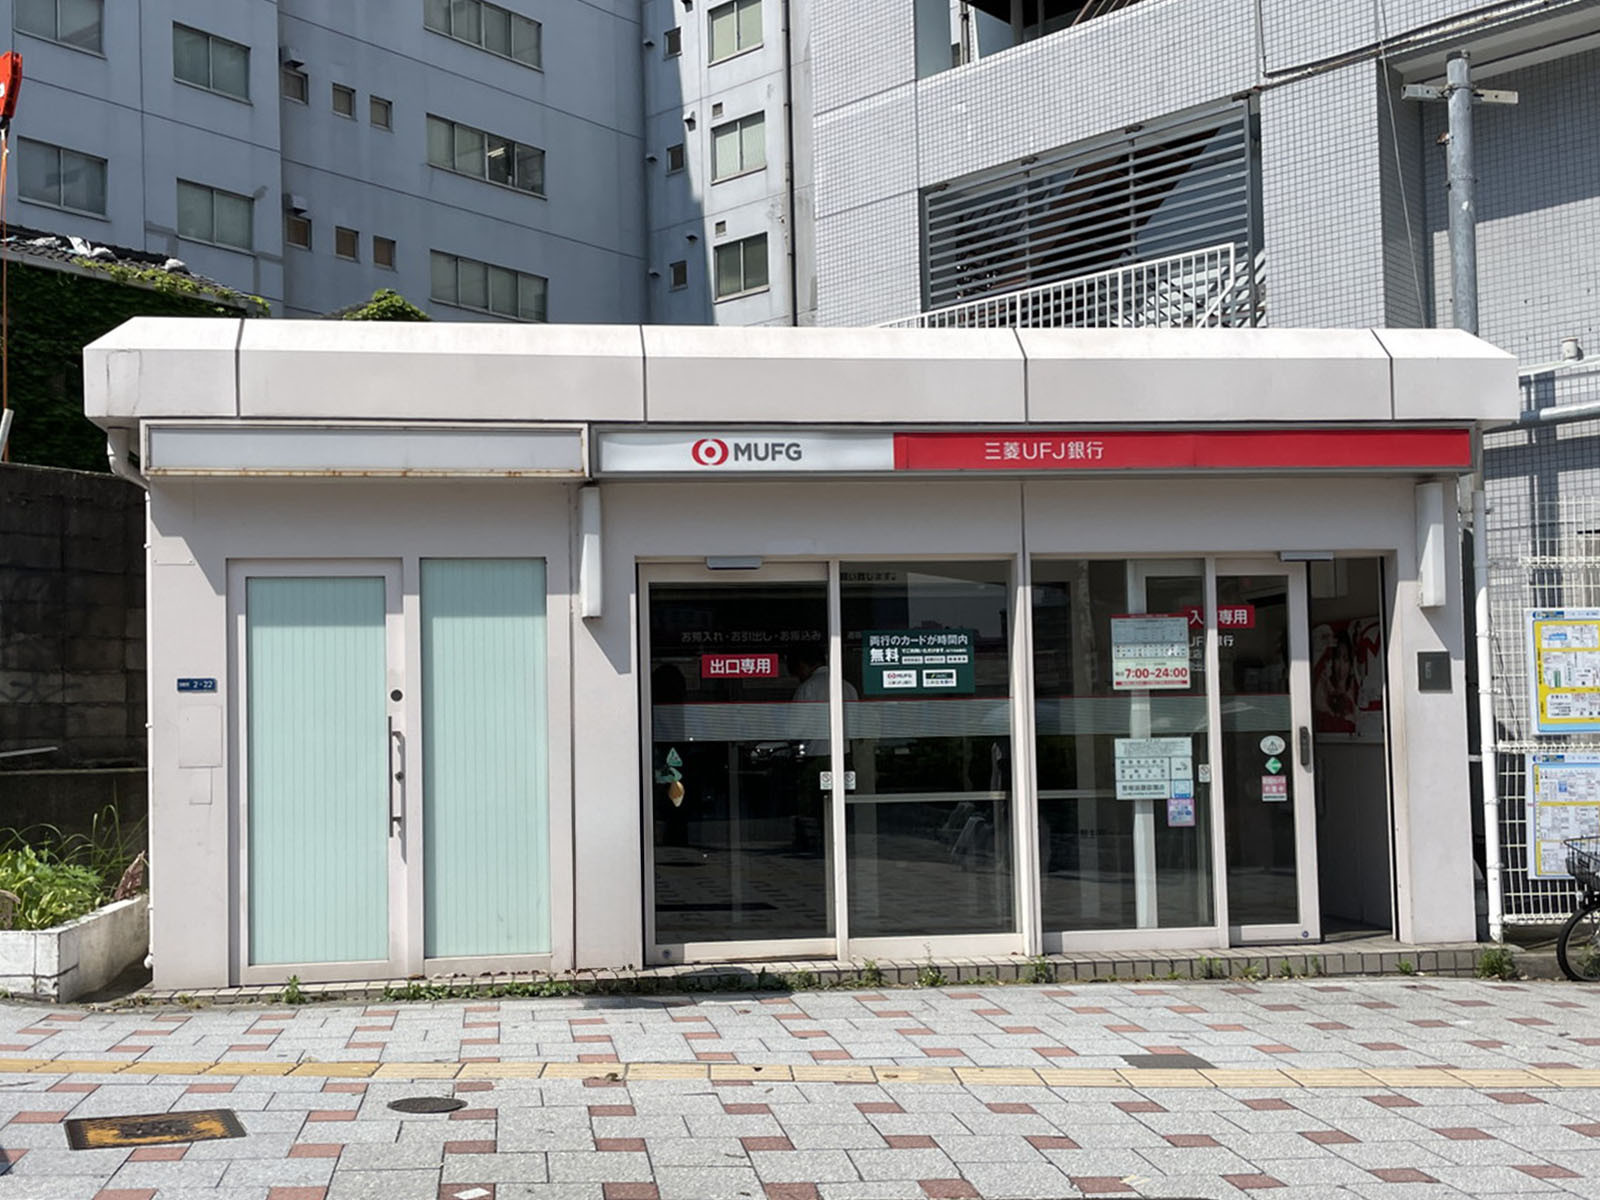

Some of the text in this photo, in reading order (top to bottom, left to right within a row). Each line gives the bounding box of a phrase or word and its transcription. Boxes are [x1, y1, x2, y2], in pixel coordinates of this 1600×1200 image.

[733, 442, 803, 462] MUFG
[984, 440, 1104, 460] 三菱UFJ銀行
[1189, 609, 1248, 625] 入専用
[869, 635, 968, 647] 両行のカードが時間内
[870, 647, 899, 663] 無料
[709, 658, 771, 675] 出口専用
